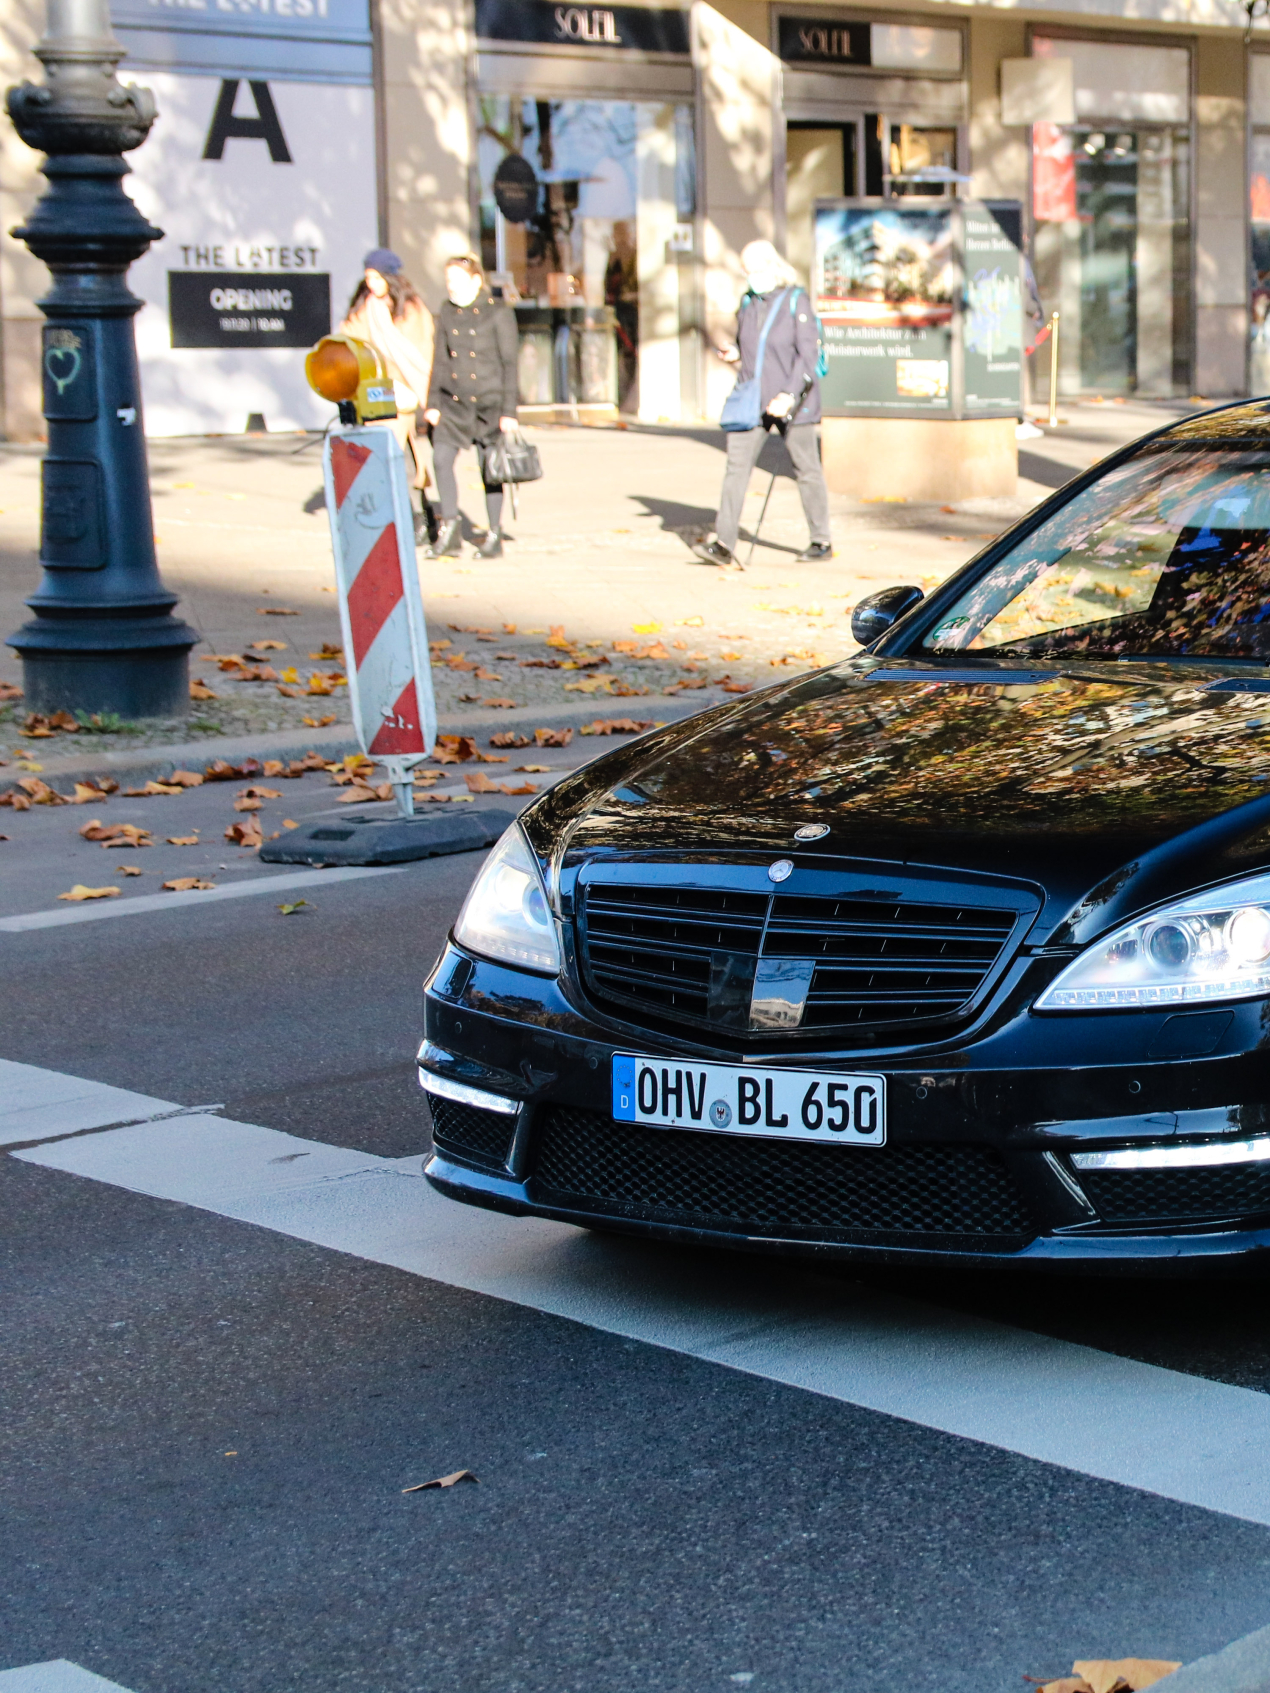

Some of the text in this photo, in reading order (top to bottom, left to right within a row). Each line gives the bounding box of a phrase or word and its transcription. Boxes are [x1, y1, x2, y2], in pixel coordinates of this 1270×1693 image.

[554, 7, 622, 43] SOLEIL
[180, 245, 226, 267] THE
[209, 287, 294, 311] OPENING
[620, 1066, 877, 1134] D OHV BL 650
